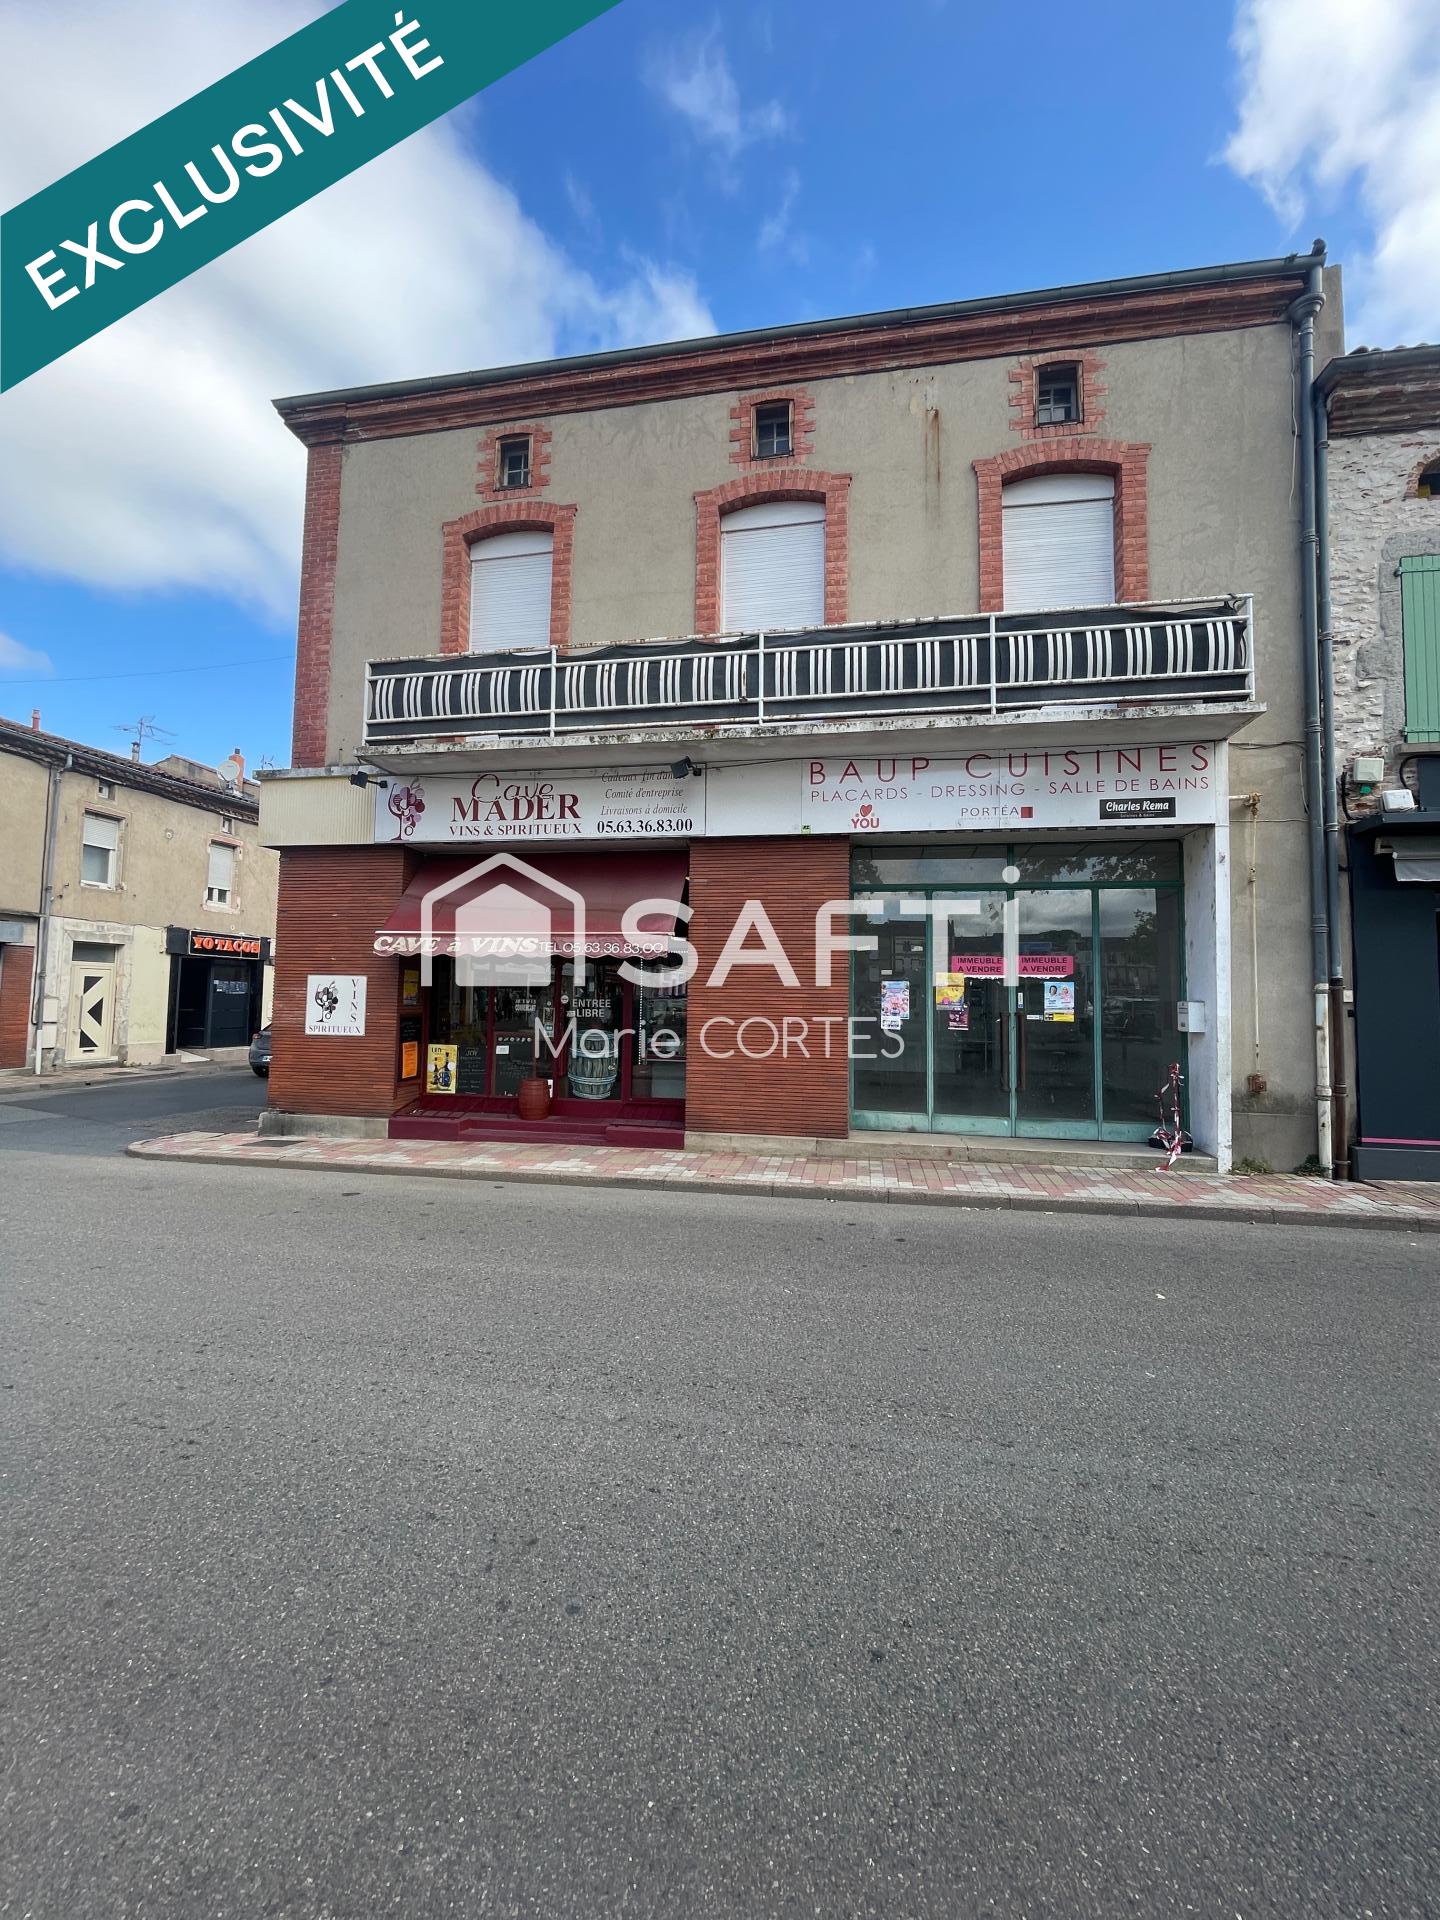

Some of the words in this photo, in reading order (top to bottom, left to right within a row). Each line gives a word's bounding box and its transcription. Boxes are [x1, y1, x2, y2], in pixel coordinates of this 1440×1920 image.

[810, 756, 930, 785] BAUP
[965, 745, 1209, 777] CUISINES
[471, 773, 554, 803] Cave
[605, 787, 632, 799] Comité
[635, 786, 683, 800] d'entreprise
[811, 787, 908, 803] PLACARDS
[931, 781, 1025, 799] DRESSING
[1049, 779, 1105, 795] SALLE
[1115, 778, 1140, 792] DE
[1150, 776, 1209, 791] BAINS
[601, 805, 642, 816] Livraisons
[653, 803, 688, 814] domicile
[961, 806, 1019, 817] PORTÉA
[1106, 801, 1140, 812] Charles
[1142, 800, 1169, 811] Rema
[450, 824, 480, 837] VINS
[484, 825, 493, 836] &
[498, 822, 582, 836] SPIRITUEUX
[597, 818, 693, 833] 05.63.36.83.00
[851, 817, 880, 829] YOU
[193, 936, 214, 949] YO
[215, 939, 259, 953] TACOS
[373, 936, 441, 952] CAVE
[472, 937, 539, 953] VINS
[966, 965, 1001, 973] VENDRE
[576, 1008, 605, 1018] LIBRE
[309, 1025, 360, 1034] SPIRITUEUX
